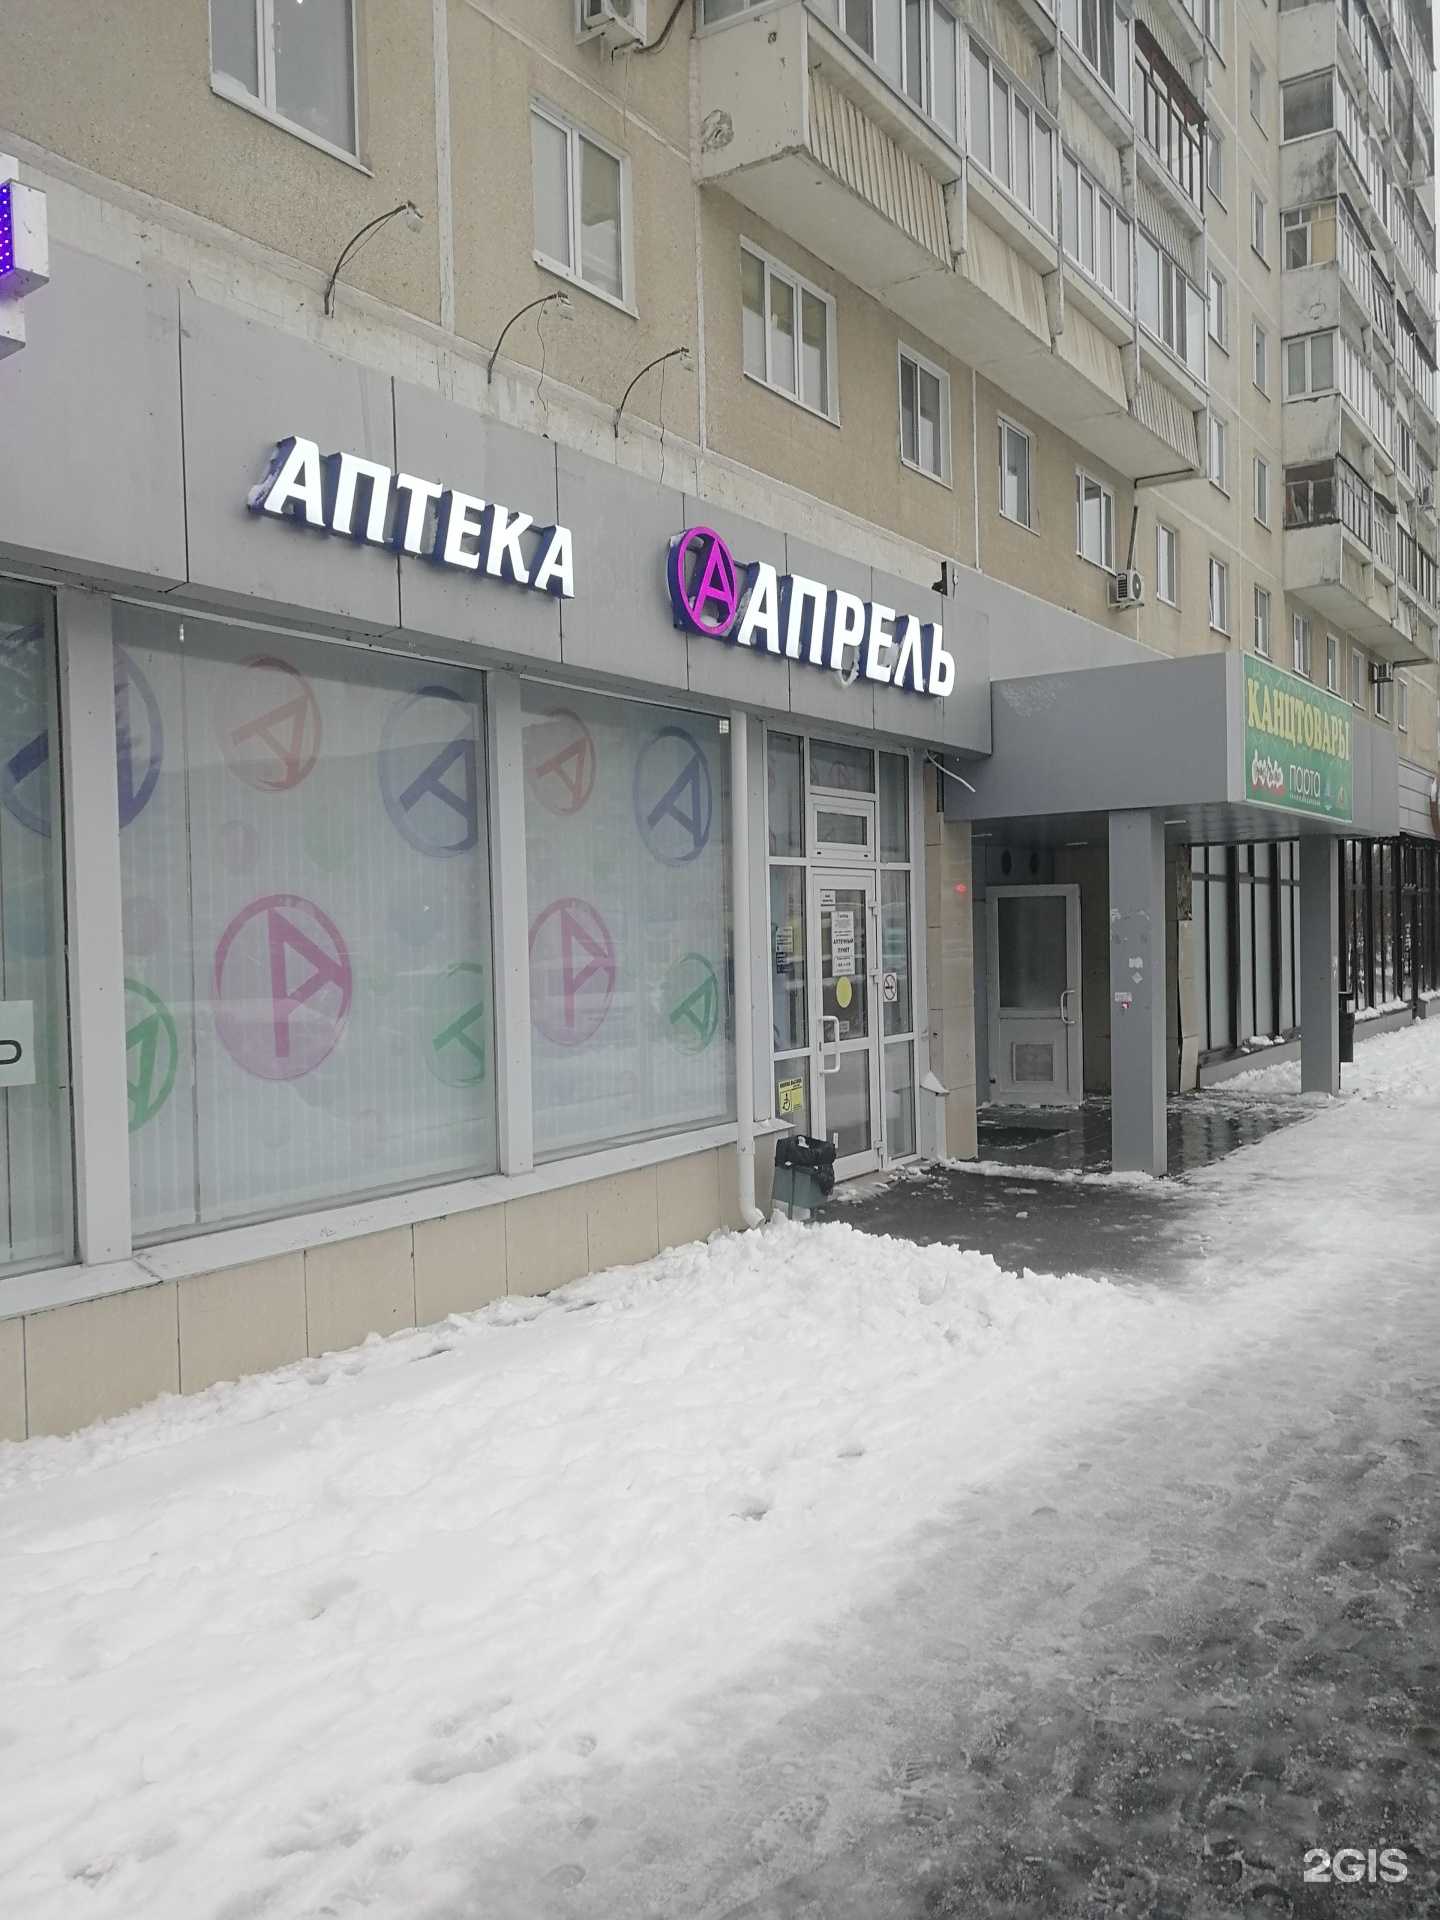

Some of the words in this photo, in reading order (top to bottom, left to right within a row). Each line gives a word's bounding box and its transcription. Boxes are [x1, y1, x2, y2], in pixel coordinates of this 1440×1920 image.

[263, 435, 576, 599] АПТЕКА
[737, 561, 956, 697] АПРЕЛЬ
[1246, 677, 1350, 761] КАНЦТОВАРЫ
